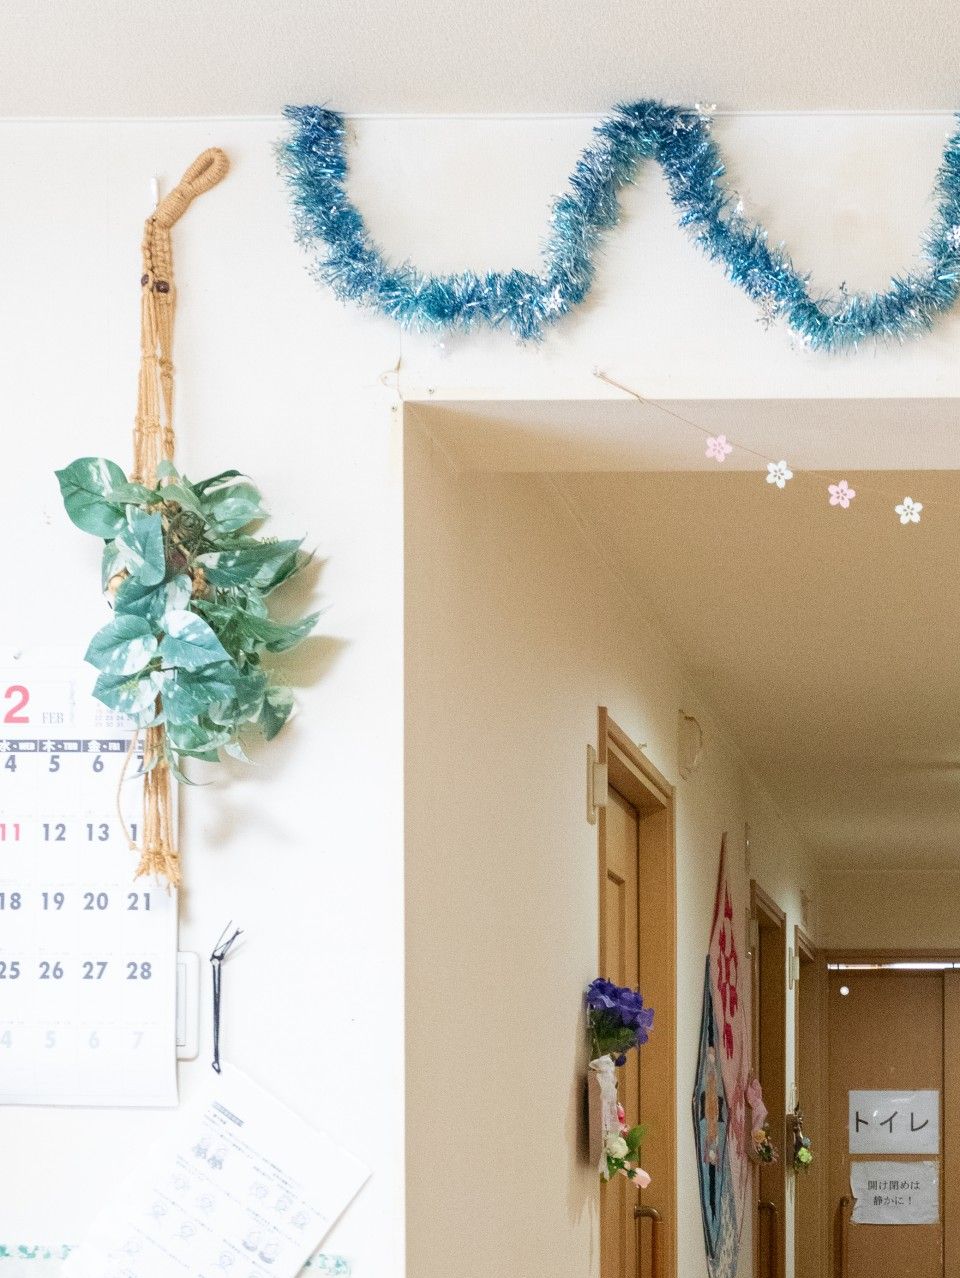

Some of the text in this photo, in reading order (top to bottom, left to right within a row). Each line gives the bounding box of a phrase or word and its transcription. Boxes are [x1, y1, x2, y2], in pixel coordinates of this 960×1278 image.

[3, 685, 30, 724] 2
[4, 754, 17, 773] 4
[49, 754, 60, 773] 5
[92, 754, 104, 773] 6
[0, 823, 21, 842] 11
[42, 823, 67, 842] 12
[86, 823, 110, 842] 13
[0, 892, 151, 911] 18 19 20 21
[39, 961, 64, 980] 26
[82, 961, 108, 980] 27
[126, 961, 152, 980] 28
[855, 1110, 929, 1133] トイレ
[867, 1180, 921, 1191] 開け閉めは
